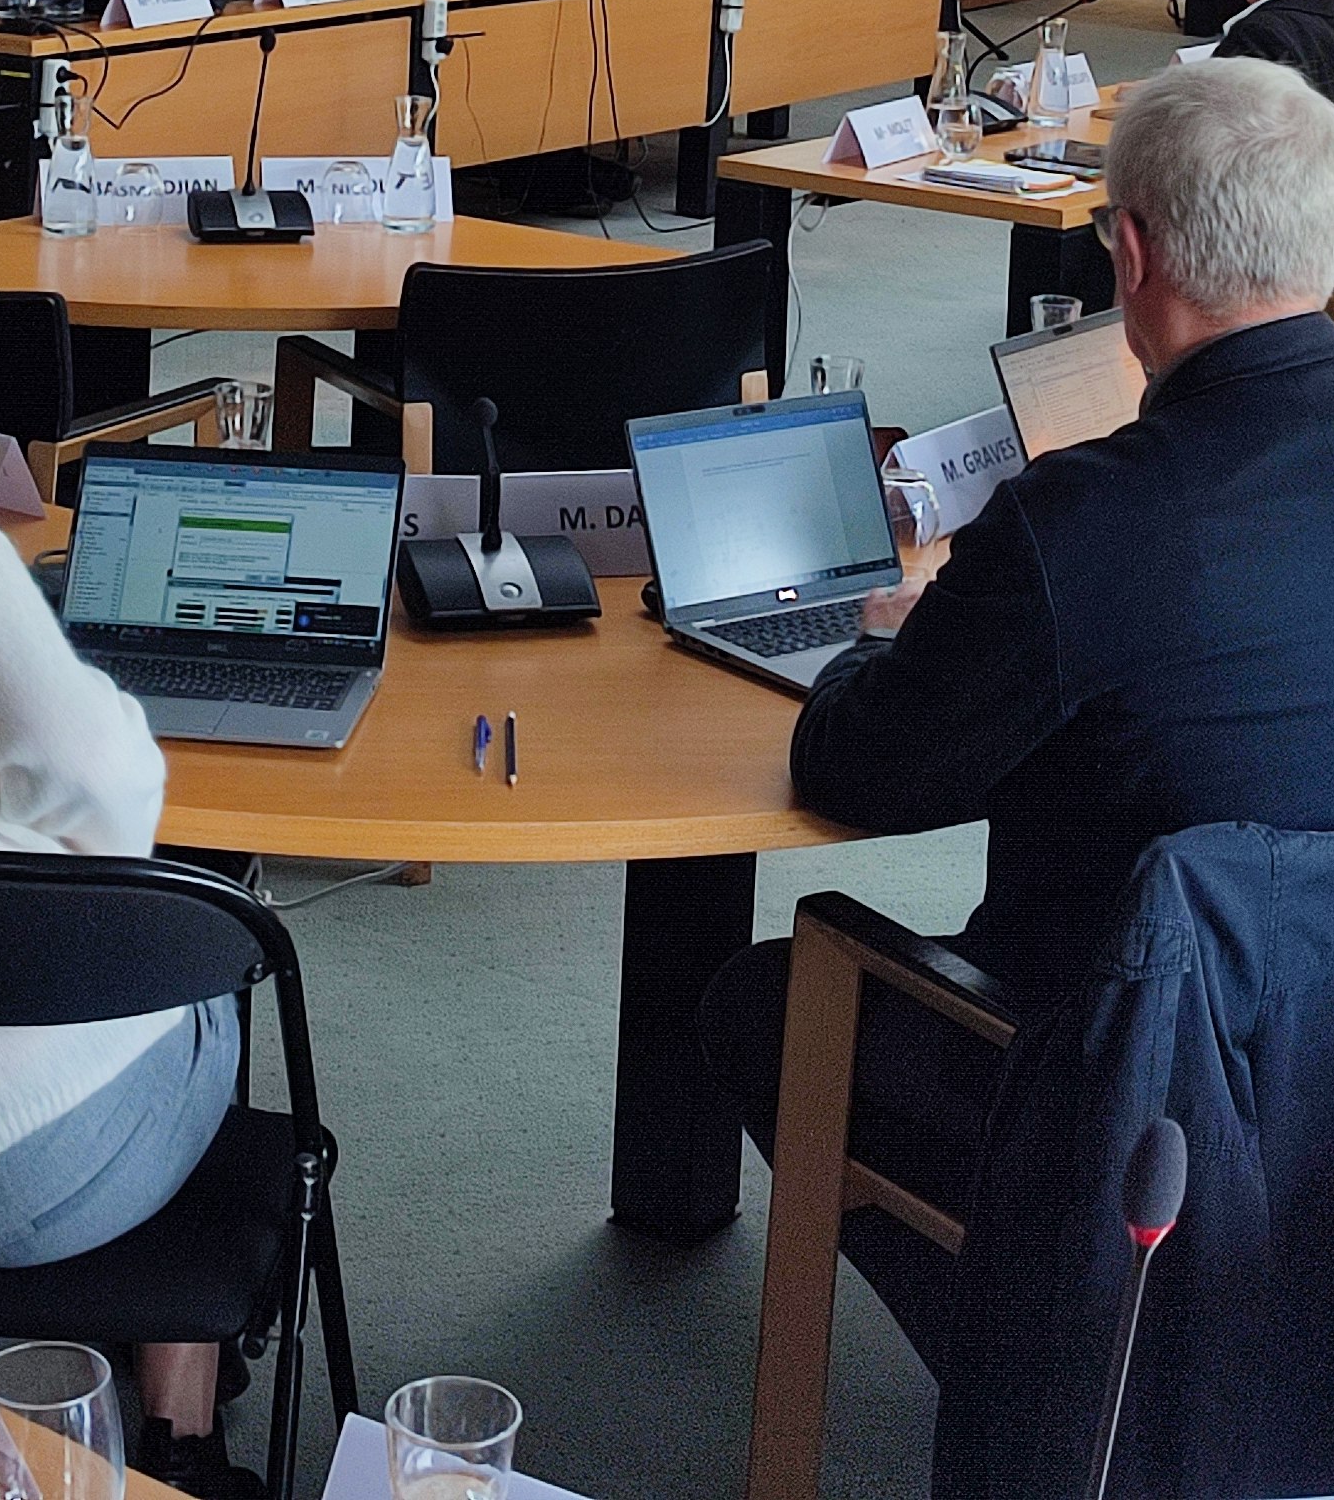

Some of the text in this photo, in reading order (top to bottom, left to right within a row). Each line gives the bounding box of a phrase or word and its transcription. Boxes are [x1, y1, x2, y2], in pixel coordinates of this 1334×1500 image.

[940, 437, 1017, 484] M. GRAVES
[559, 506, 596, 531] M.
